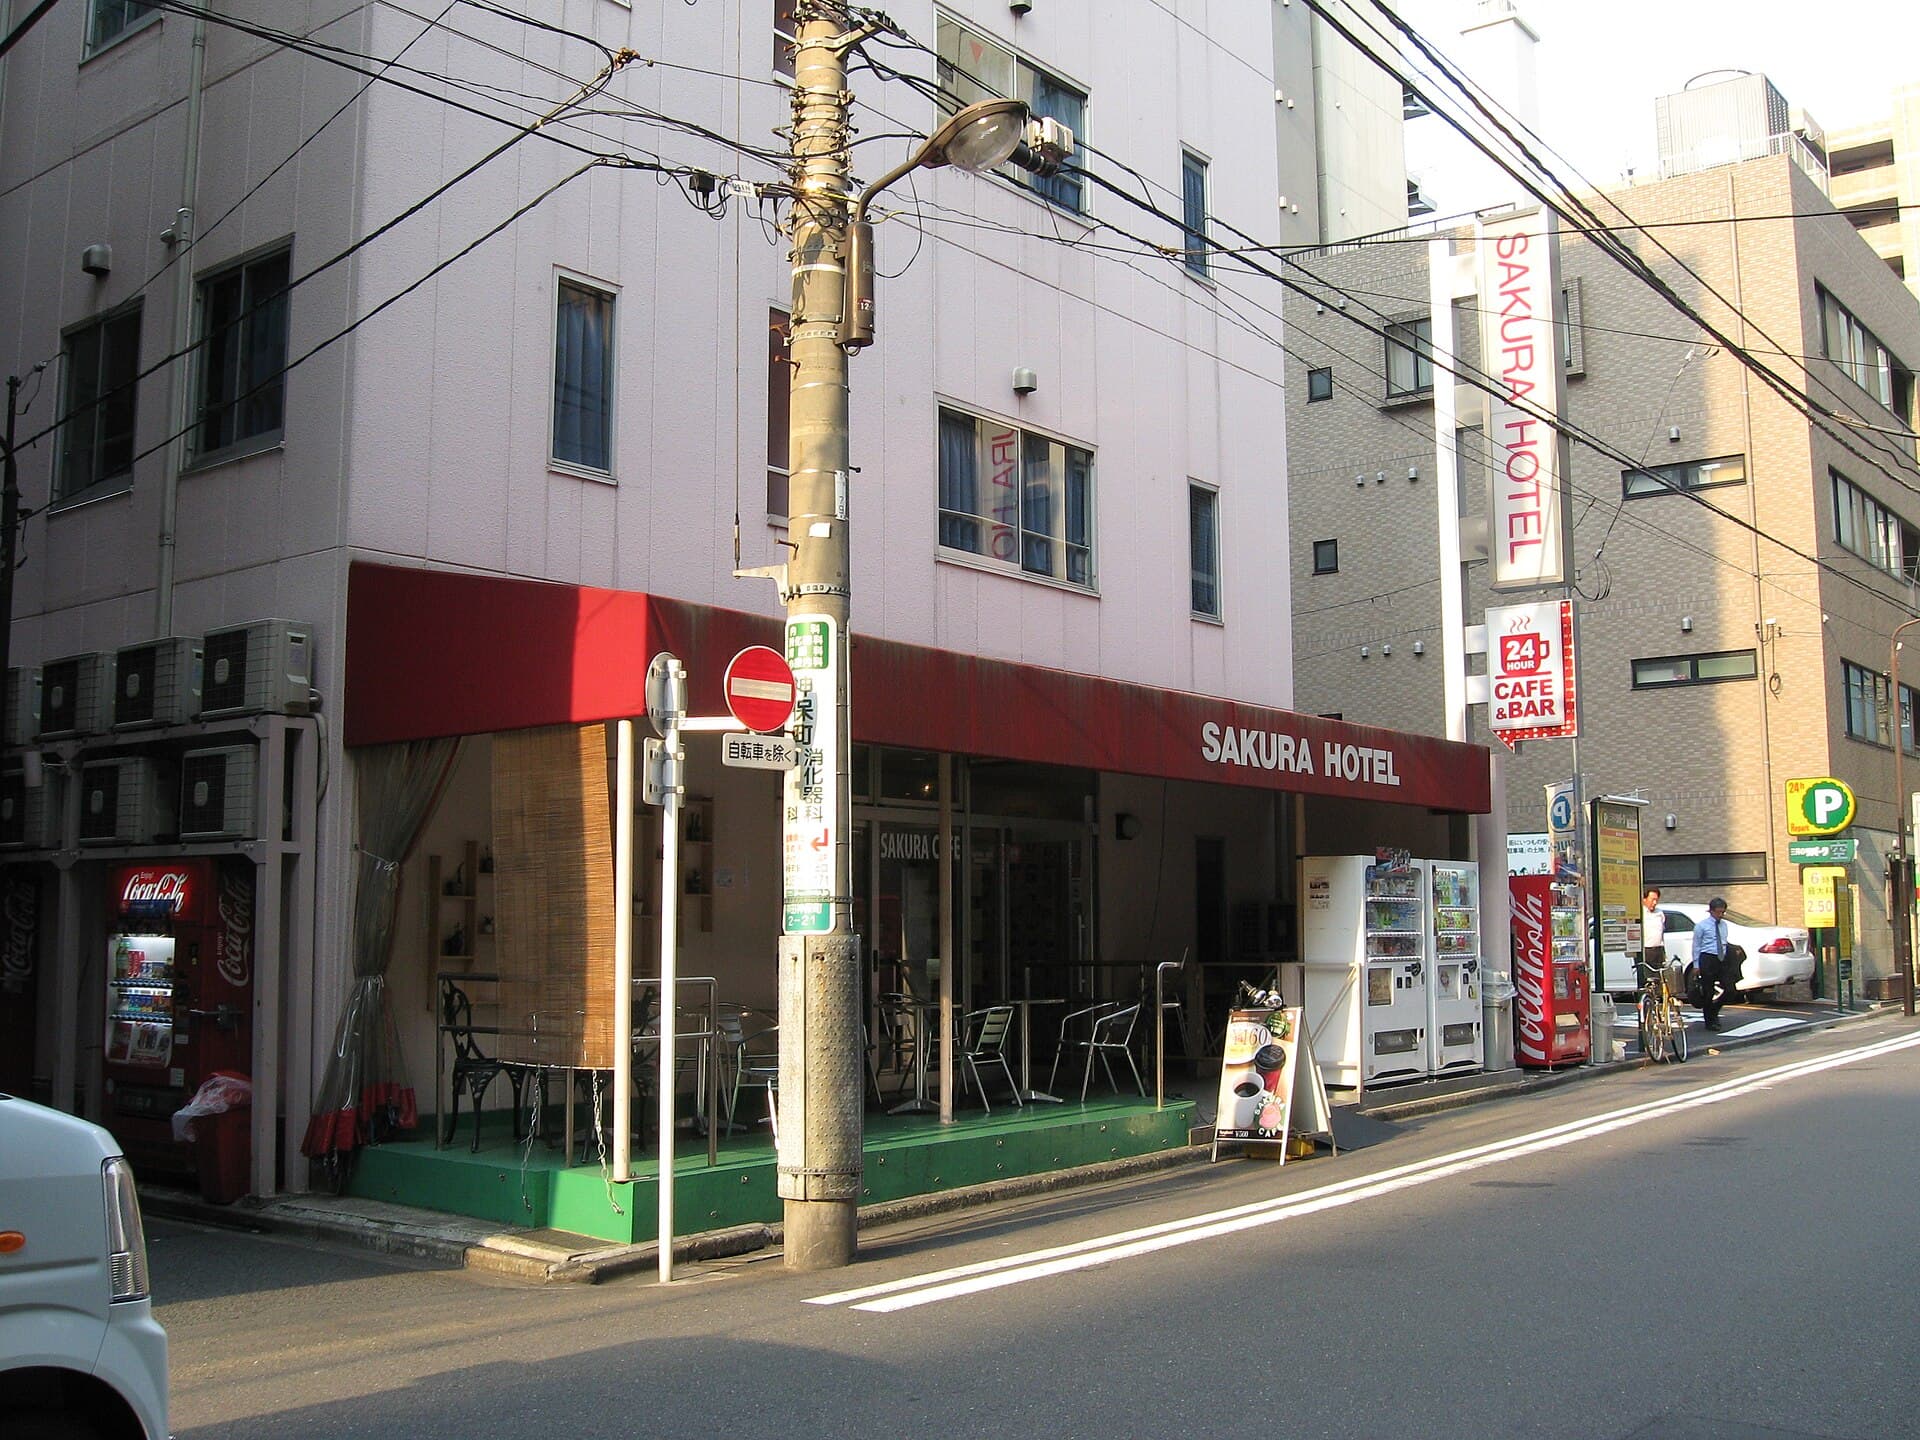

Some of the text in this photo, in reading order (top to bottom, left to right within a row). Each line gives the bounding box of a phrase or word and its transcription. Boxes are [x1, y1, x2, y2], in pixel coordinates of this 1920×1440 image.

[1496, 231, 1542, 565] SAKURA HOTEL
[1505, 639, 1535, 661] 24
[1506, 660, 1535, 671] HOUR
[1494, 678, 1553, 700] CAFE
[729, 741, 792, 762] 自転車を除く
[1202, 721, 1400, 786] SAKURA HOTEL
[1814, 788, 1843, 825] P
[880, 832, 961, 860] SAKURA CE
